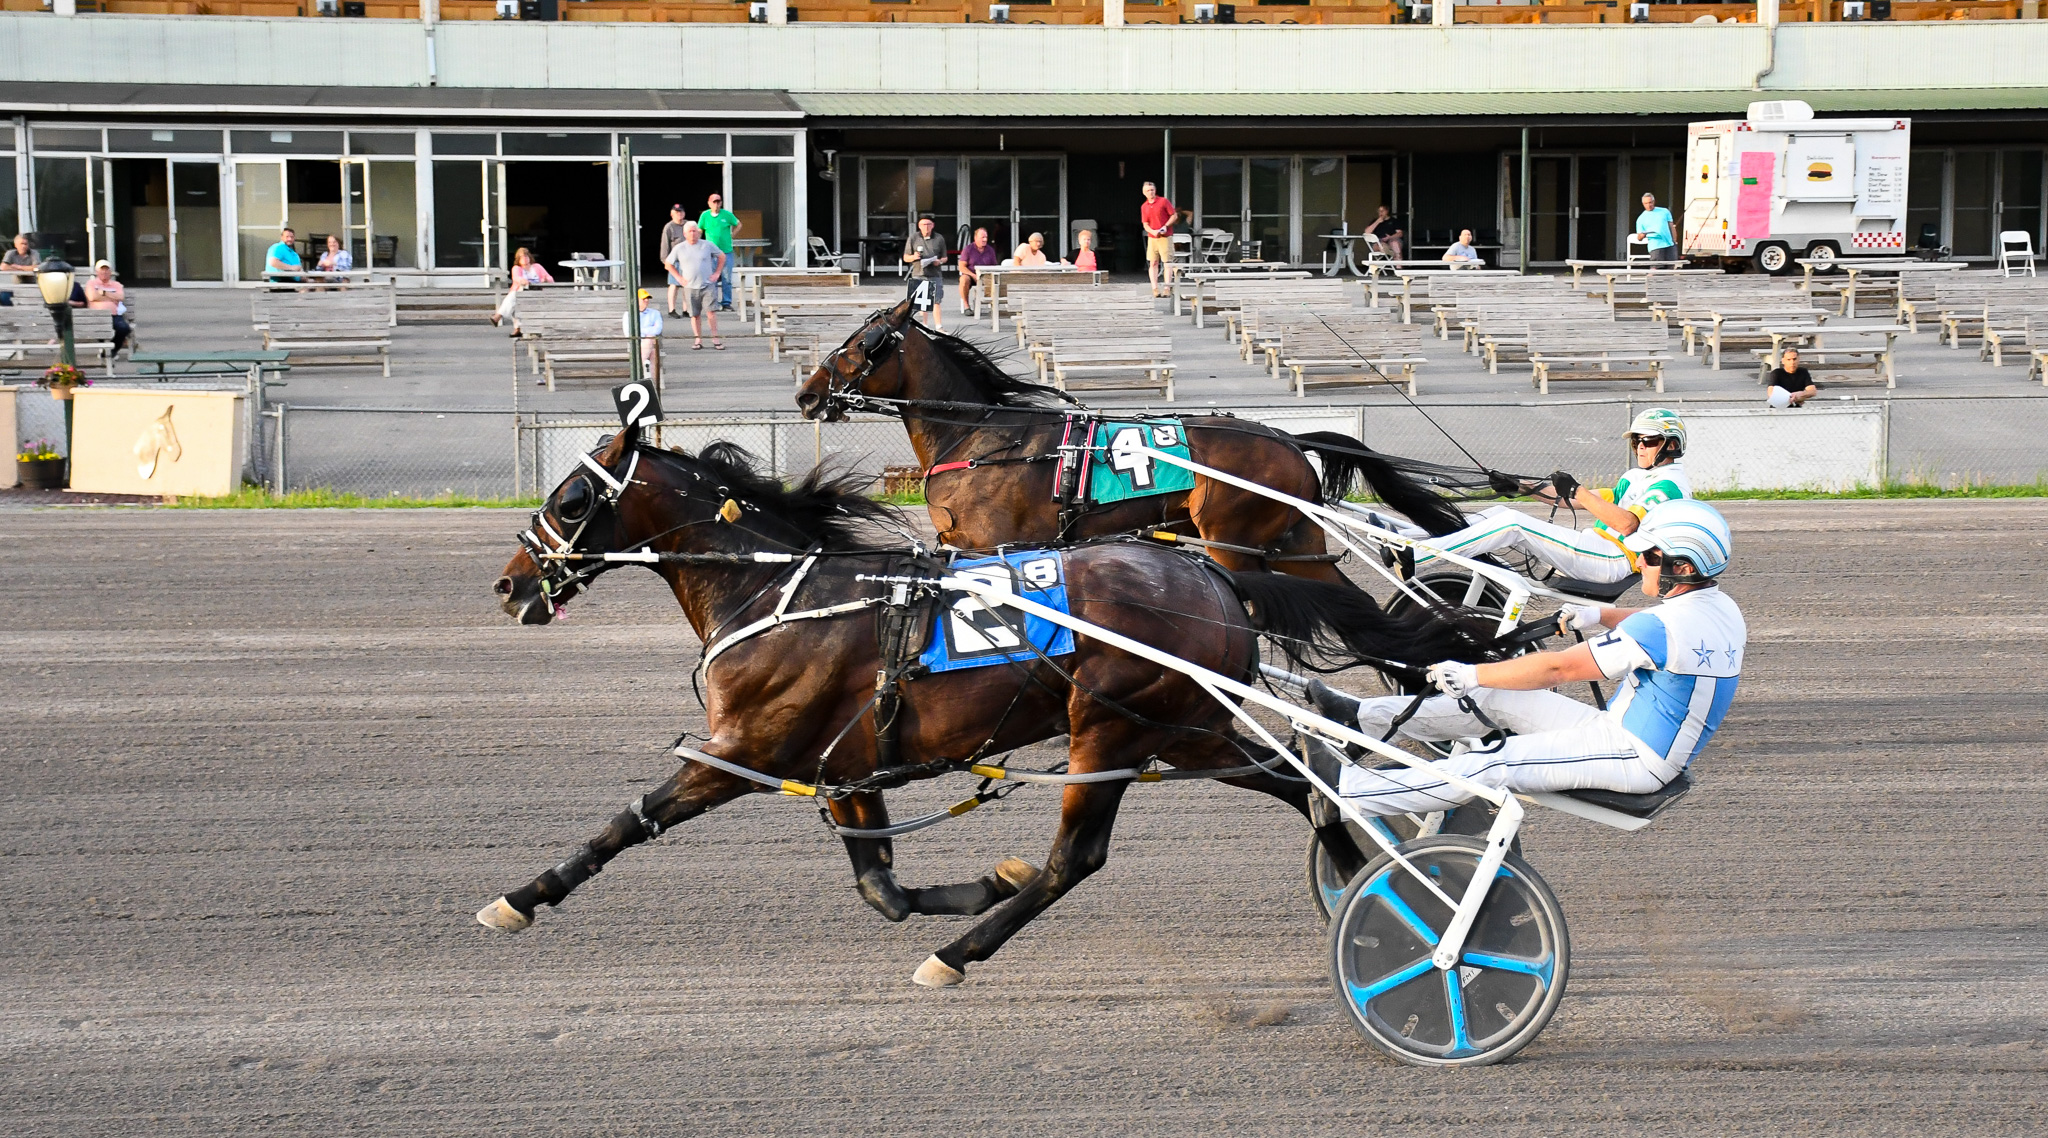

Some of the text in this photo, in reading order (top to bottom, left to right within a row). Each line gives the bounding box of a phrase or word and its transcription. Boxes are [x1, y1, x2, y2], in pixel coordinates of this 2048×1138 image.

[910, 280, 932, 312] 4
[620, 383, 658, 427] 2
[1152, 425, 1178, 447] 8
[1110, 426, 1155, 489] 4
[1023, 558, 1058, 589] 8
[950, 565, 1021, 654] 2
